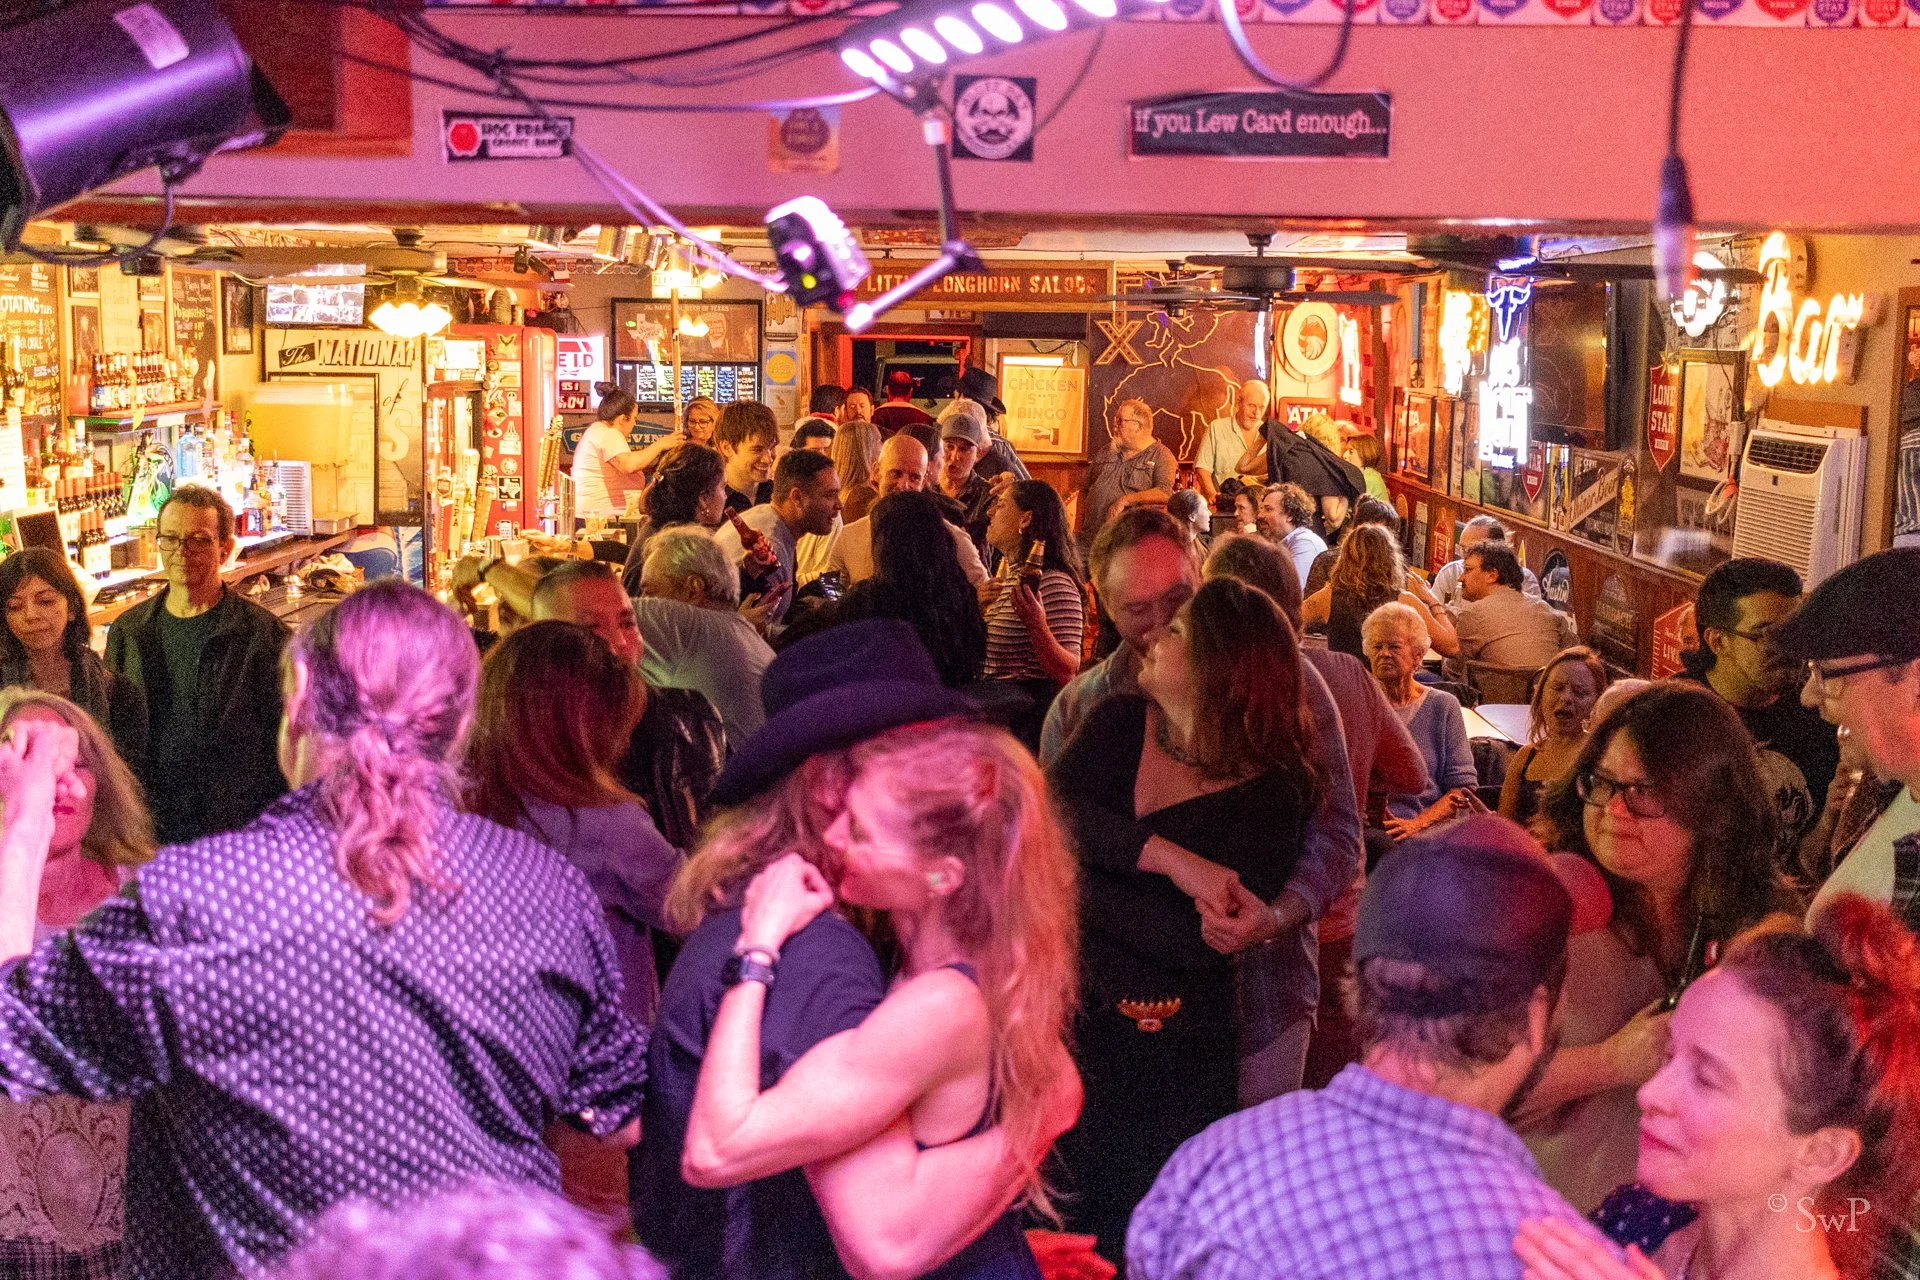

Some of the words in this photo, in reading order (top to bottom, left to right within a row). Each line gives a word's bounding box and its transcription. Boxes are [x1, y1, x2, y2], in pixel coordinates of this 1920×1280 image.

[1152, 113, 1192, 138] you
[1196, 108, 1239, 133] Lew
[1242, 108, 1292, 133] Card
[867, 274, 911, 293] LITT
[1029, 275, 1096, 293] SALOON
[0, 295, 39, 314] OTATING
[281, 346, 311, 367] The
[558, 353, 567, 367] E
[1008, 377, 1078, 392] CHICKEN
[1652, 384, 1677, 407] LONE
[1017, 408, 1067, 421] BINGO
[1650, 410, 1675, 434] STAR
